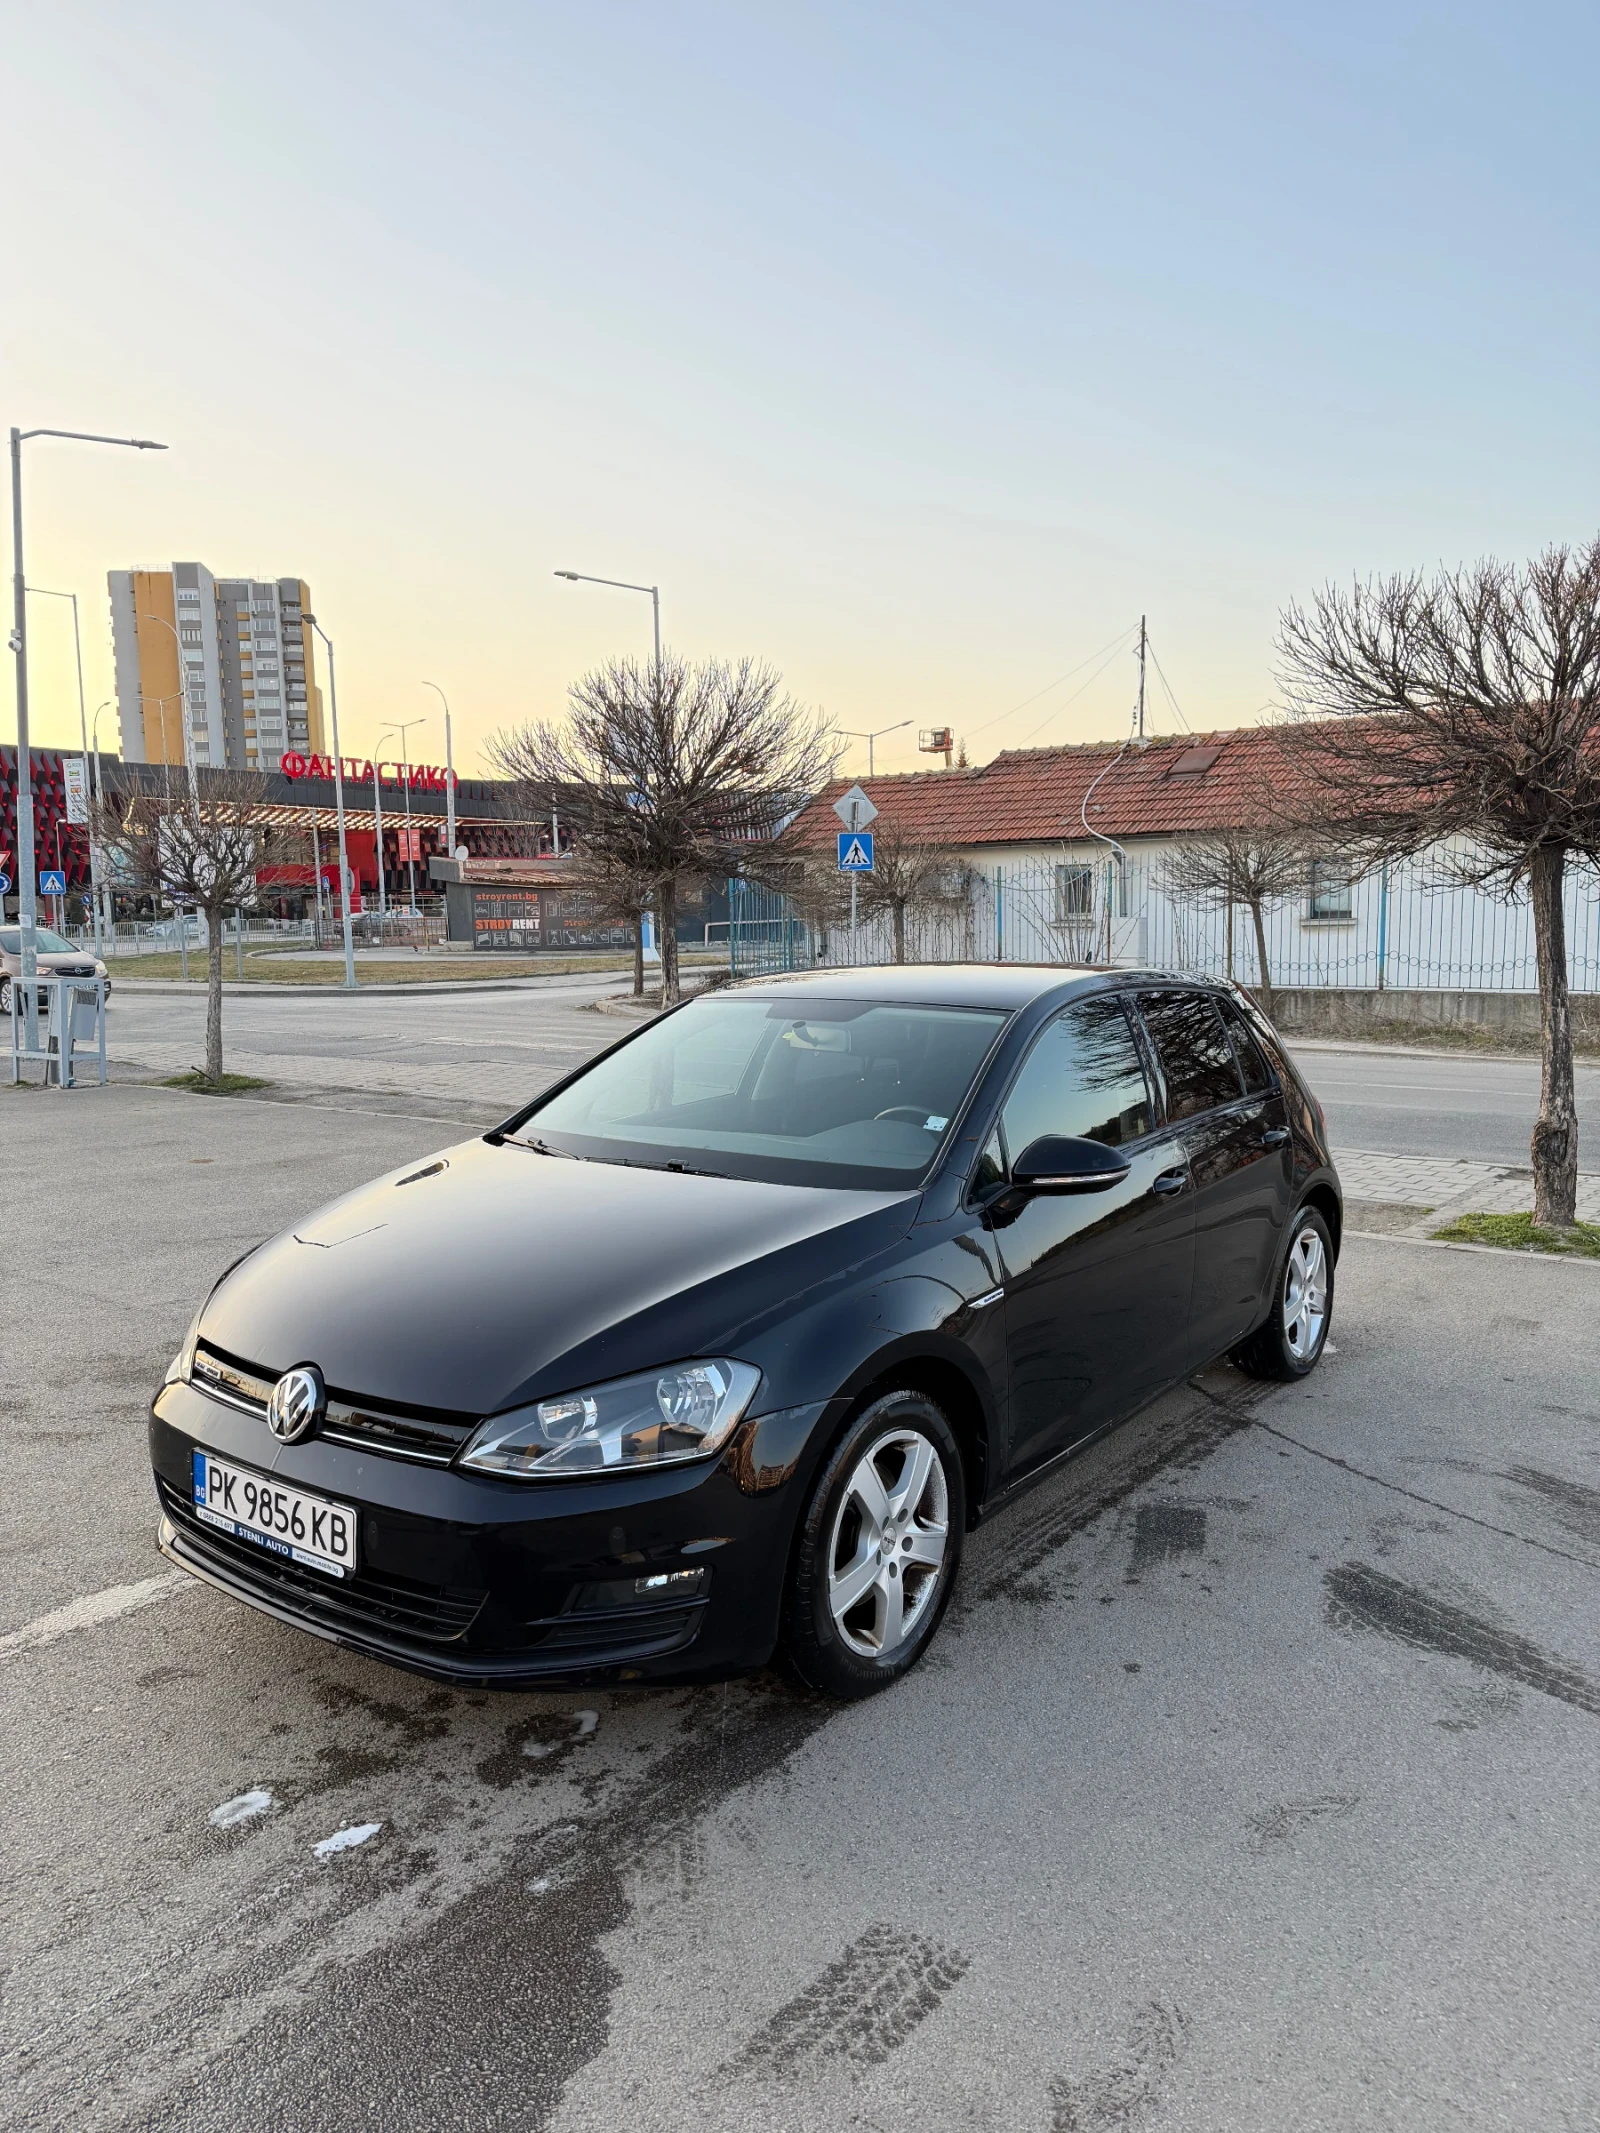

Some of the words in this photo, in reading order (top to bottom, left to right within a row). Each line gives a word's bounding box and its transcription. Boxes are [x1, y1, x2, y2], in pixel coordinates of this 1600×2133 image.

[281, 750, 458, 790] ФАНТАСТИКО
[475, 891, 538, 902] stroyrent.bg
[475, 918, 540, 930] STROYRENT
[195, 1485, 205, 1498] BG
[208, 1465, 238, 1515] PK
[243, 1481, 306, 1541] 9856
[311, 1505, 349, 1558] KB
[238, 1527, 264, 1545] STENLI
[266, 1540, 289, 1555] AUTO
